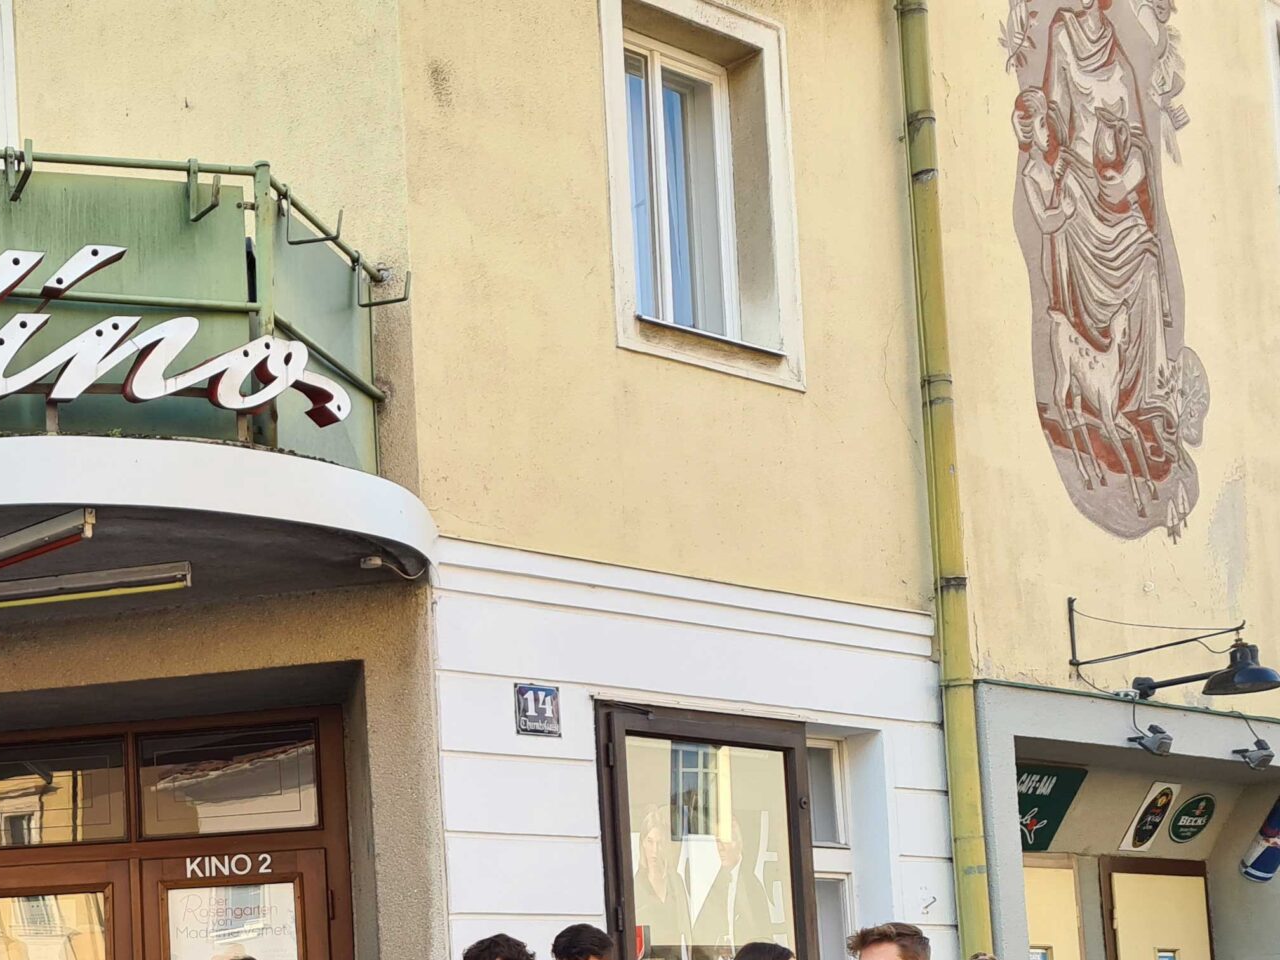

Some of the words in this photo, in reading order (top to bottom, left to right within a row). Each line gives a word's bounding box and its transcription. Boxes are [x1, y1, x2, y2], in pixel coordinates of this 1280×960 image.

[523, 690, 553, 717] 14
[185, 853, 252, 878] KINO
[257, 853, 272, 873] 2
[180, 893, 278, 924] Rosengarten
[211, 919, 233, 927] von
